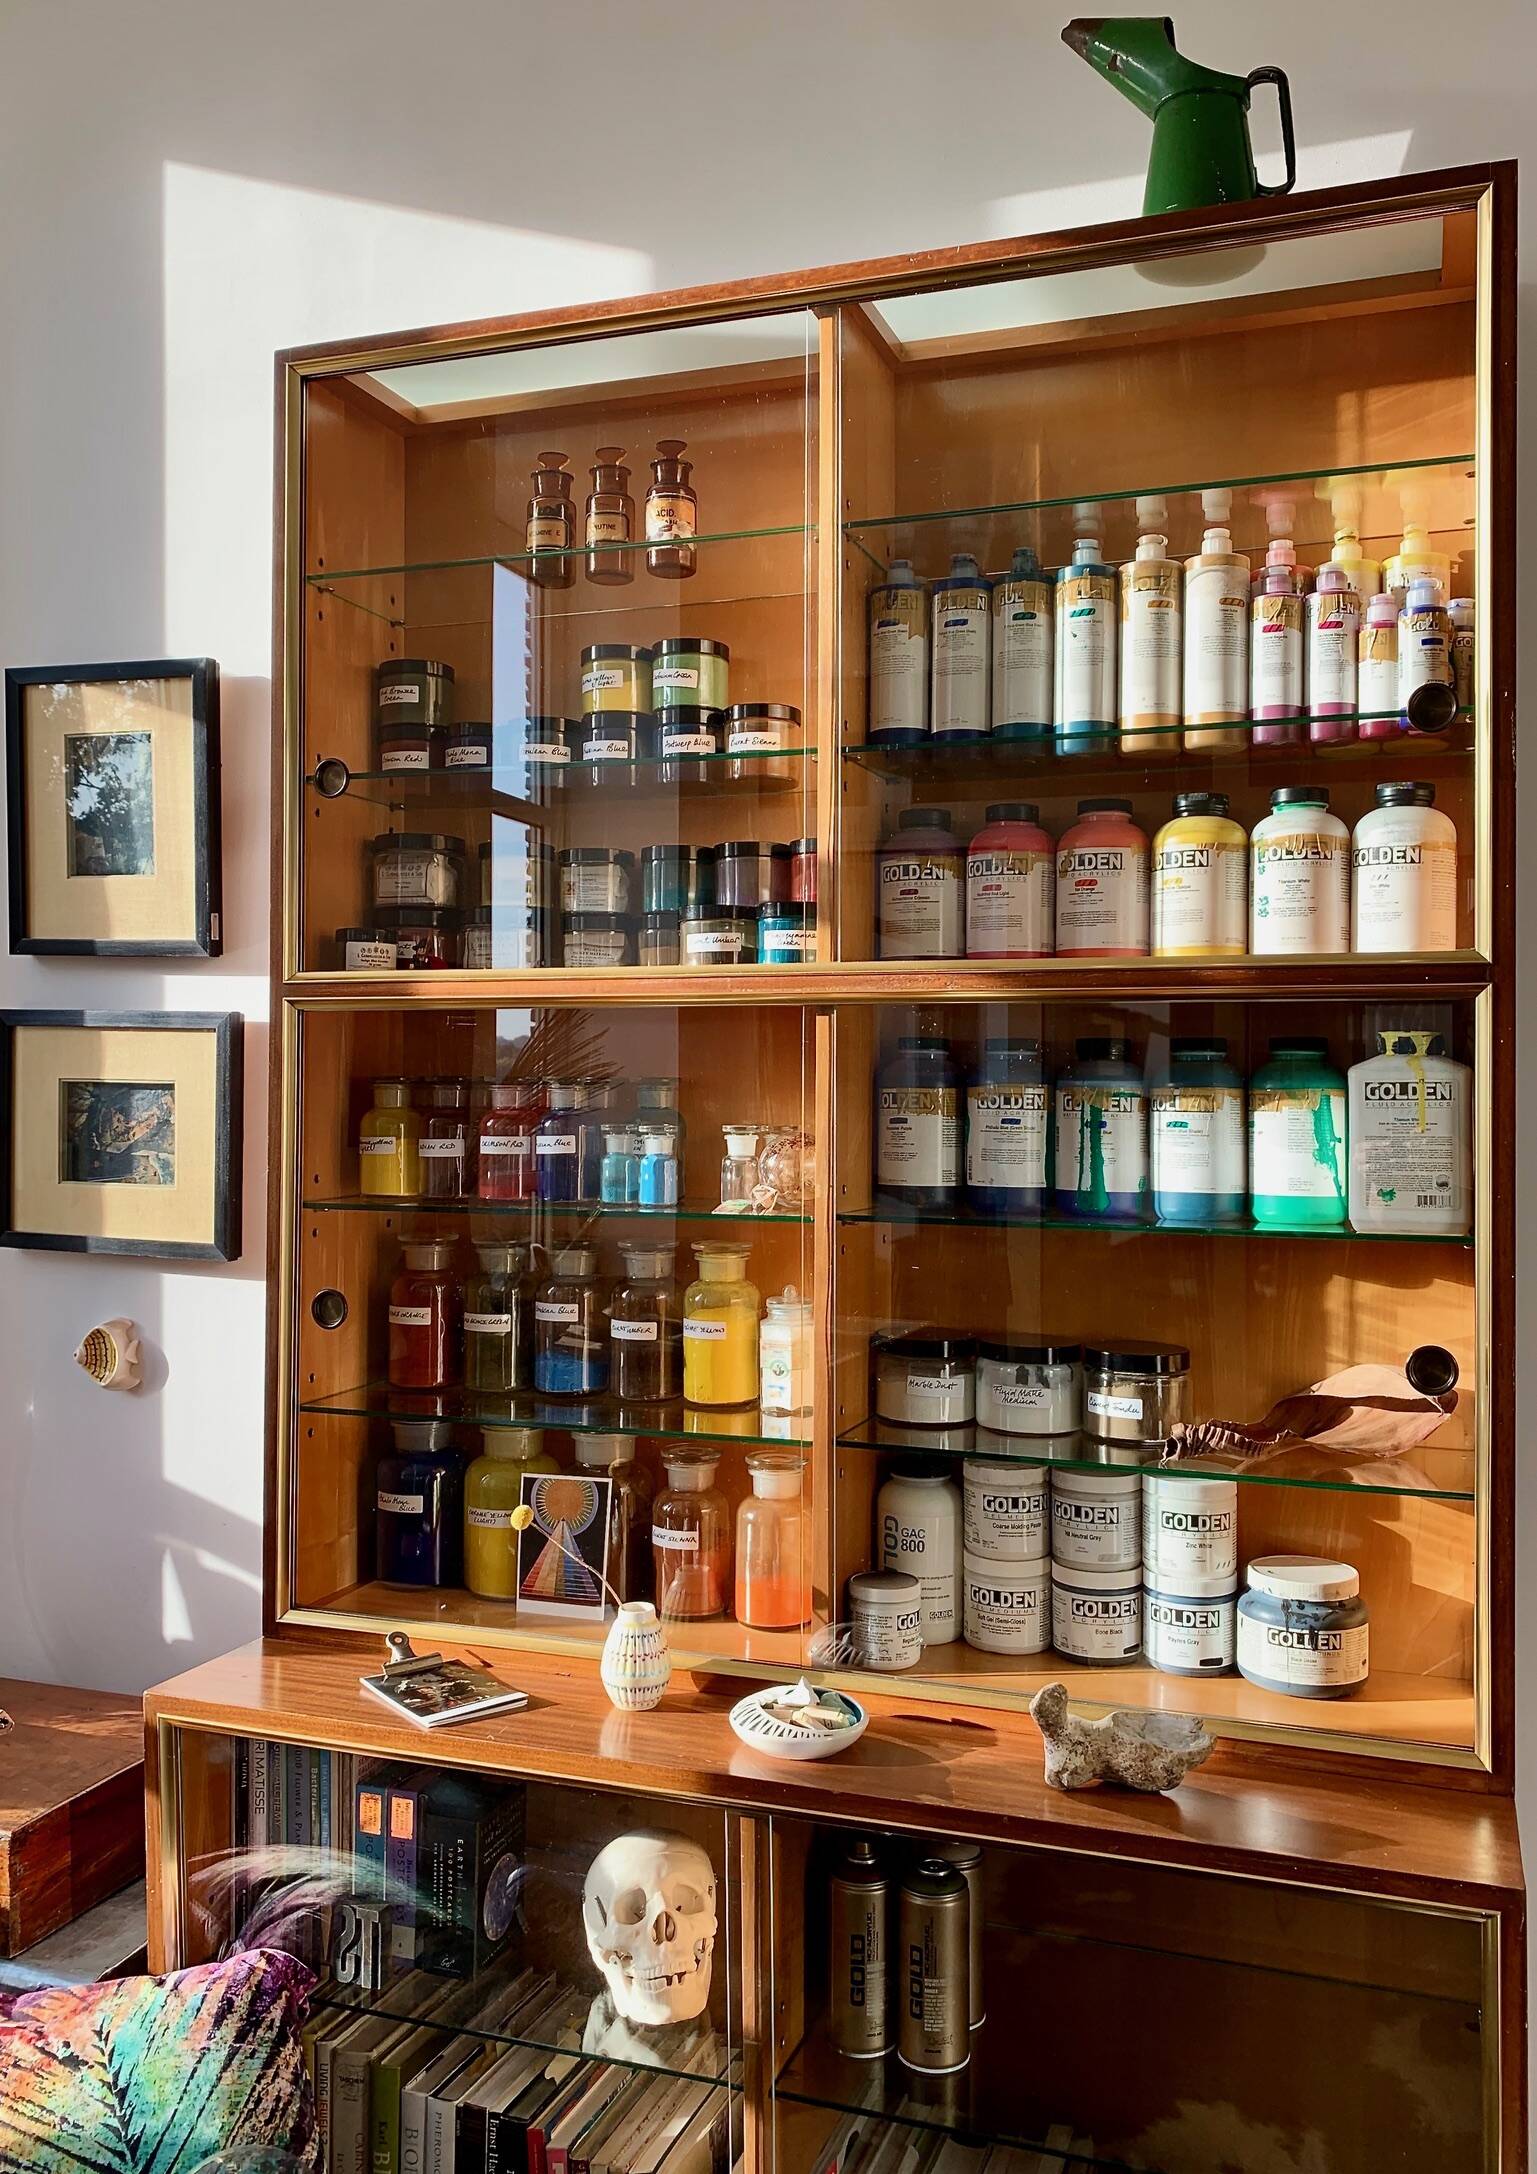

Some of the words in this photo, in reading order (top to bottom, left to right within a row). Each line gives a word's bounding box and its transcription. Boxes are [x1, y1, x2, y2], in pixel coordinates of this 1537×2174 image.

[1455, 636, 1472, 647] GO
[551, 746, 569, 757] Blue
[606, 742, 628, 752] Blue
[693, 738, 711, 747] Blue
[1353, 846, 1422, 868] GOLDEN
[883, 864, 944, 883] GOLDEN
[967, 859, 1028, 878] GOLDEN
[1365, 1082, 1452, 1100] GOLDEN
[880, 1093, 931, 1110] OLDEN
[977, 1095, 1045, 1110] GOLDEN
[510, 1140, 525, 1148] RED
[558, 1306, 577, 1315] Blue
[908, 1379, 933, 1389] Marble
[934, 1381, 958, 1390] Dust
[993, 1386, 1017, 1398] Fluid
[1018, 1388, 1045, 1398] Matte
[1001, 1396, 1039, 1406] Medium
[983, 1494, 1048, 1513] GOLDEN
[1054, 1500, 1120, 1524] GOLDEN
[992, 1522, 1010, 1530] Coarse
[1161, 1511, 1231, 1532] GOLDEN
[901, 1528, 926, 1538] GAC
[1072, 1531, 1088, 1540] Neutral
[1088, 1534, 1102, 1542] Gray
[883, 1515, 898, 1572] GOL
[901, 1539, 926, 1553] 800
[970, 1584, 1037, 1608] GOLDEN
[1072, 1598, 1139, 1619] GOLDEN
[1151, 1603, 1220, 1628] GOLDEN
[1187, 1637, 1200, 1646] Gray
[255, 1740, 265, 1754] RI
[254, 1757, 265, 1815] MATISSE
[310, 1768, 319, 1806] Bacteria
[456, 1838, 464, 1880] EARTH
[850, 1934, 865, 2007] GOLD
[909, 1944, 923, 2021] GOLD
[319, 2063, 328, 2096] LIVING
[319, 2099, 328, 2137] JEWELS
[379, 2121, 388, 2145] Karl
[489, 2118, 499, 2150] Ernst
